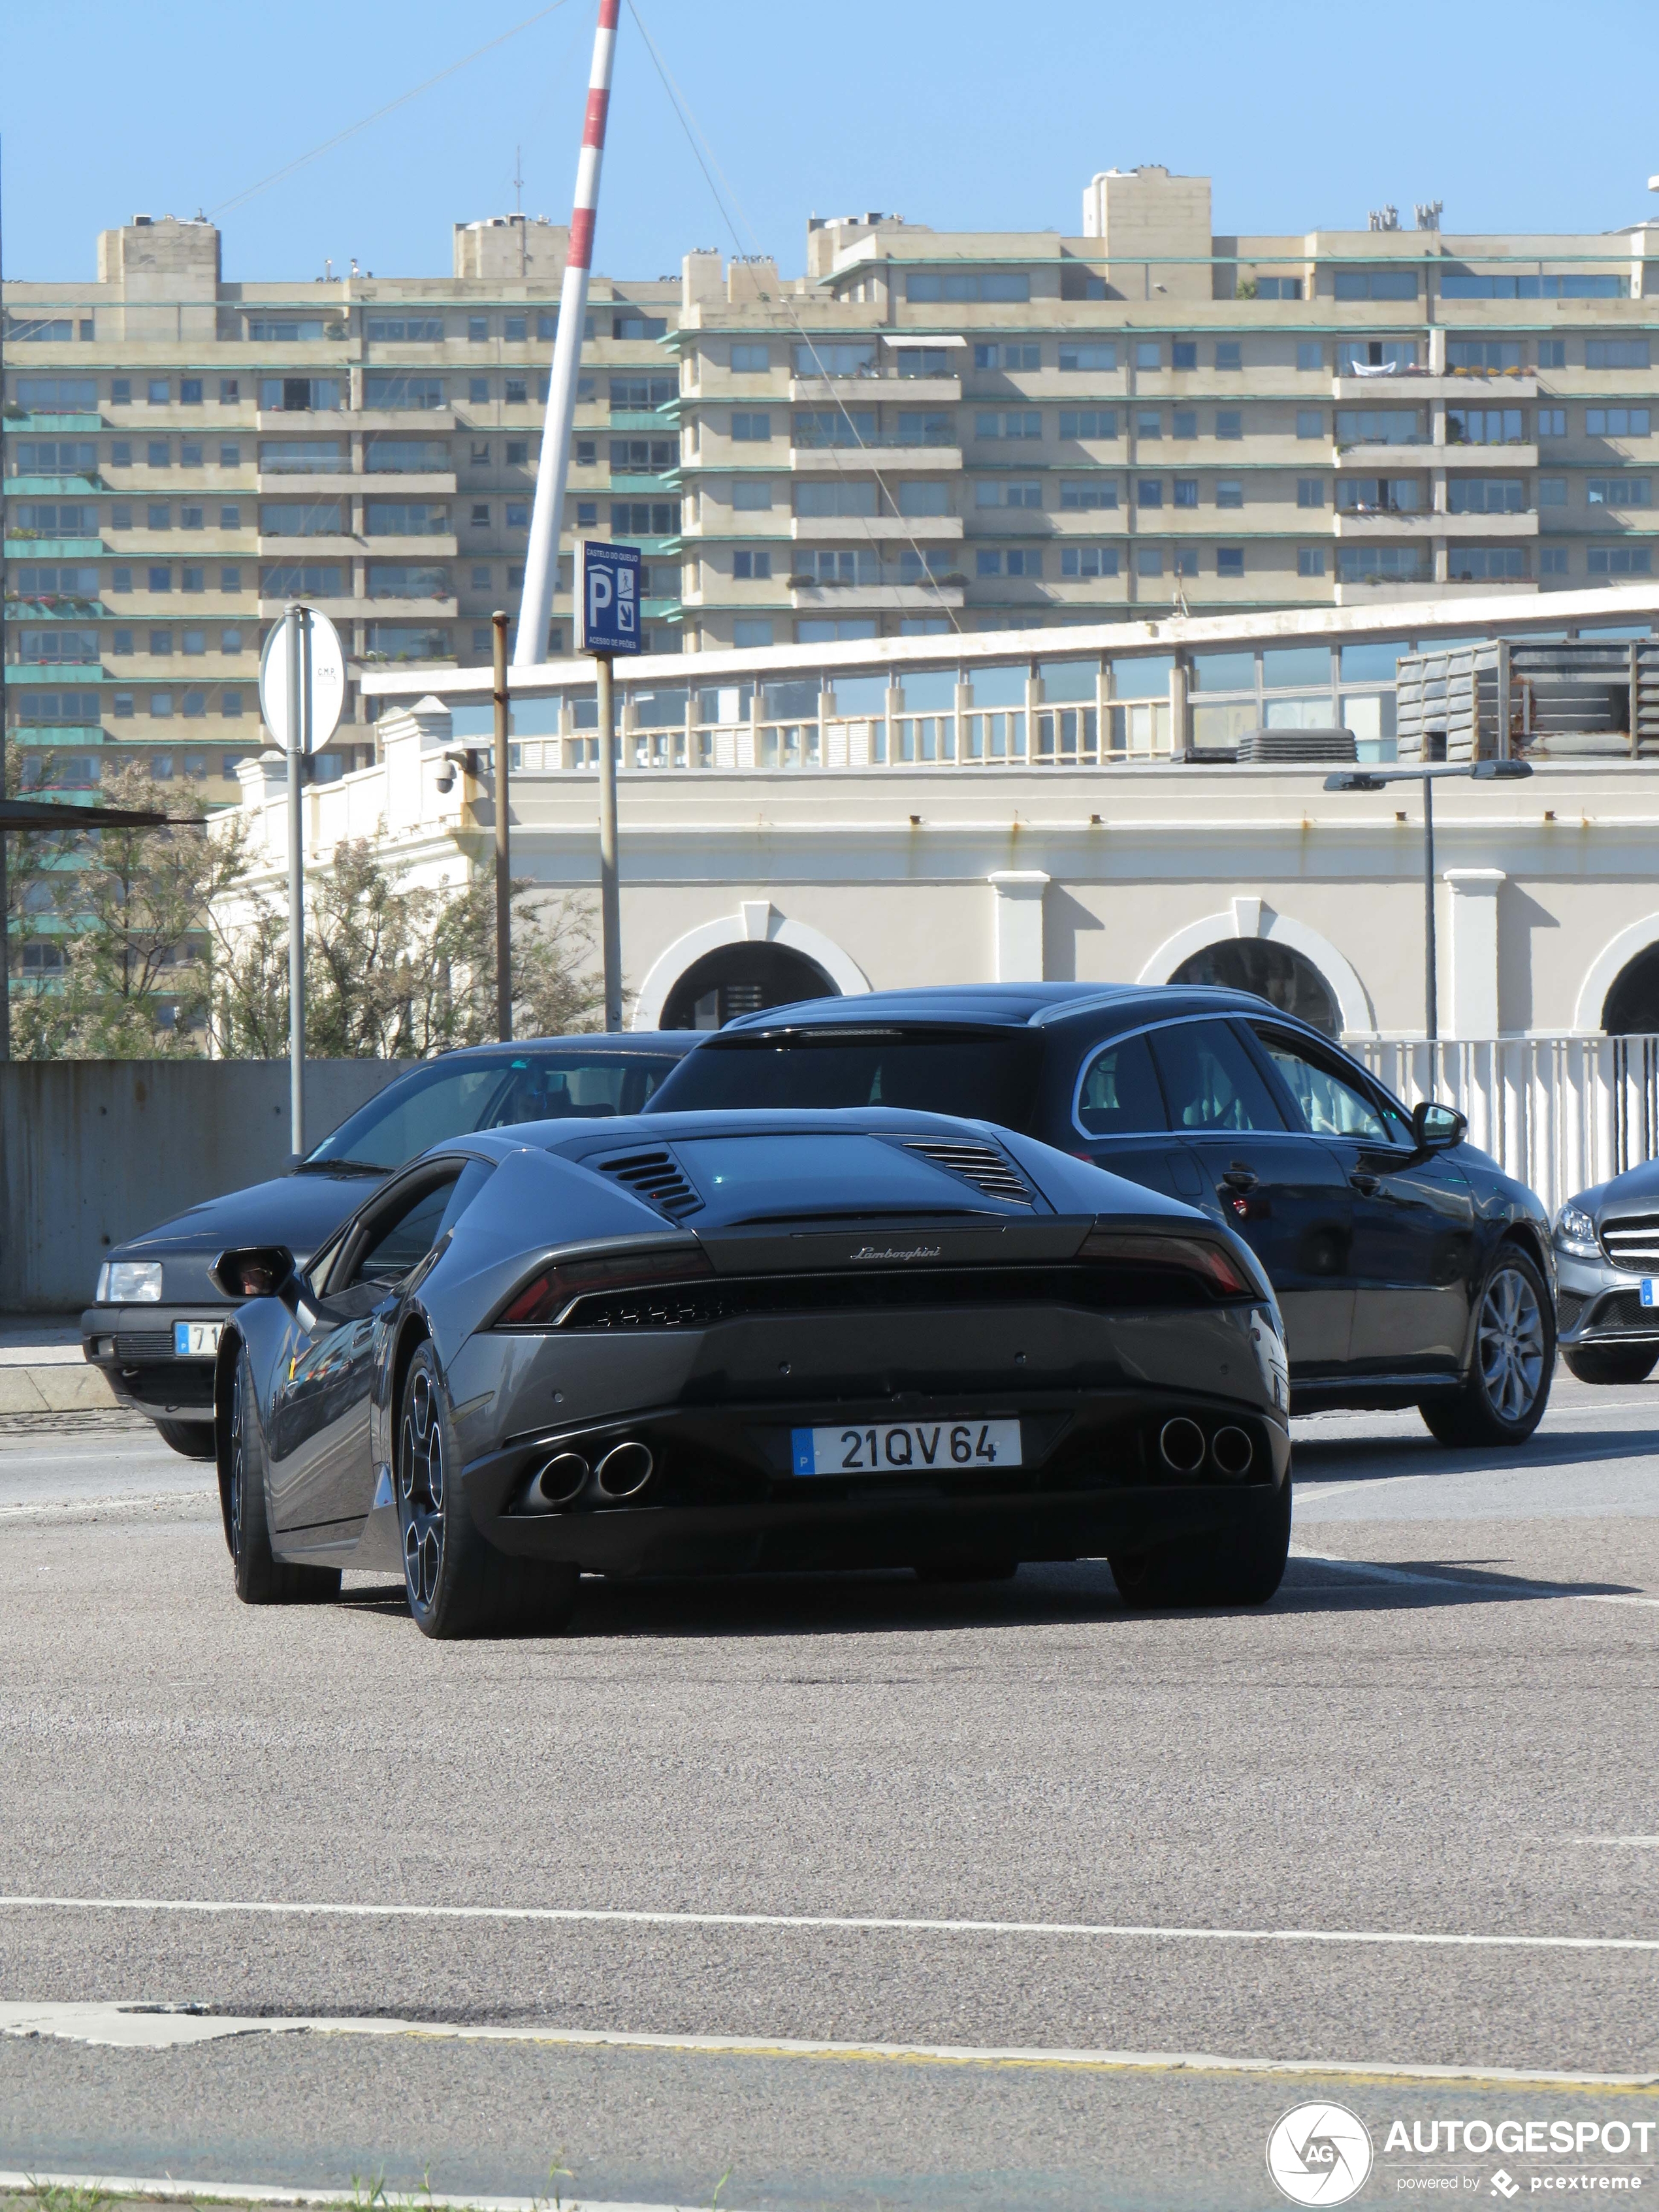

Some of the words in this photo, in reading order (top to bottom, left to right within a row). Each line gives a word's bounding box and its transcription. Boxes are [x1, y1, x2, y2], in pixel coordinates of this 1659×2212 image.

[587, 549, 610, 558] CASTELO
[619, 553, 638, 562] QUEIJO
[590, 572, 612, 628] P
[589, 636, 610, 645] ACESSO
[619, 639, 636, 649] PEÕES
[850, 1247, 941, 1260] Lamborghini
[800, 1456, 809, 1467] P
[841, 1425, 997, 1468] 21QV64
